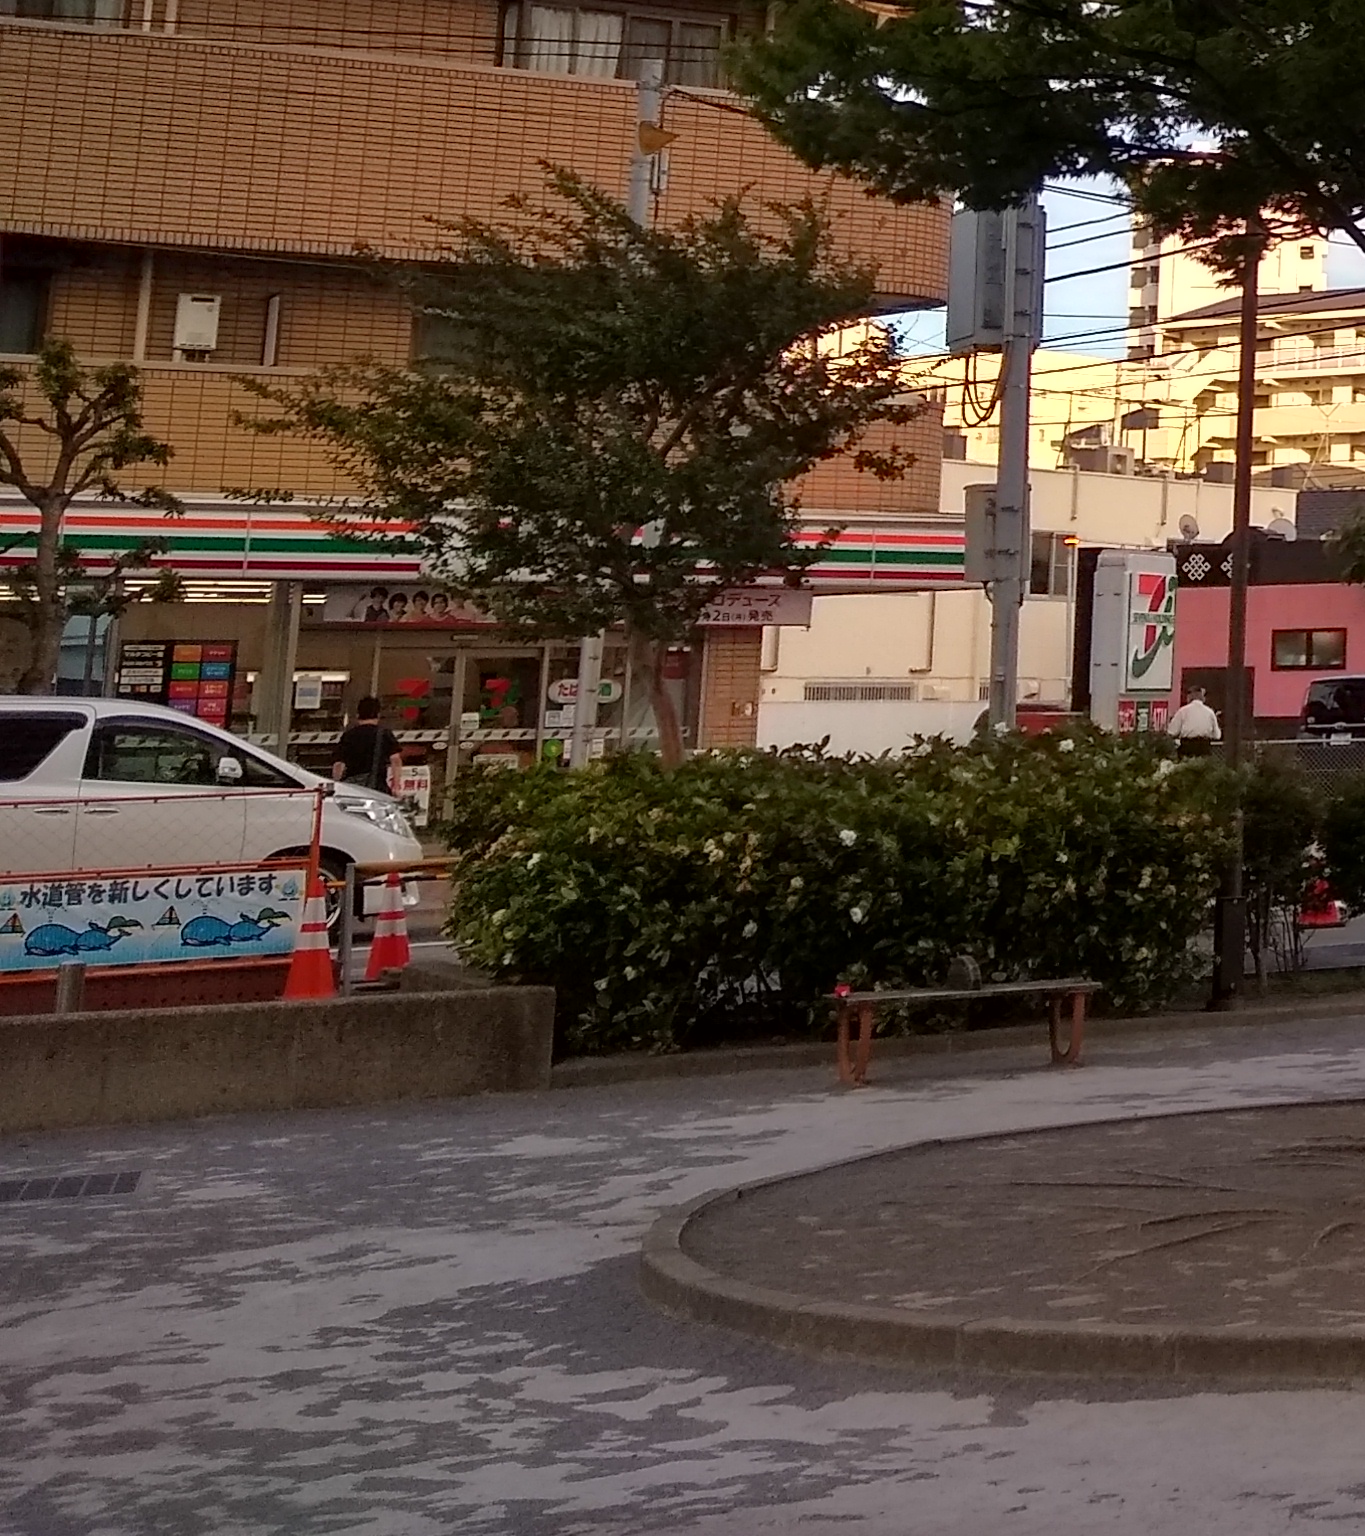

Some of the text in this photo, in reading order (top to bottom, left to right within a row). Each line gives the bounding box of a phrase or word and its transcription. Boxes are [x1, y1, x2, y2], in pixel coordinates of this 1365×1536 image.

[19, 872, 279, 909] 水道管を新しくしています
